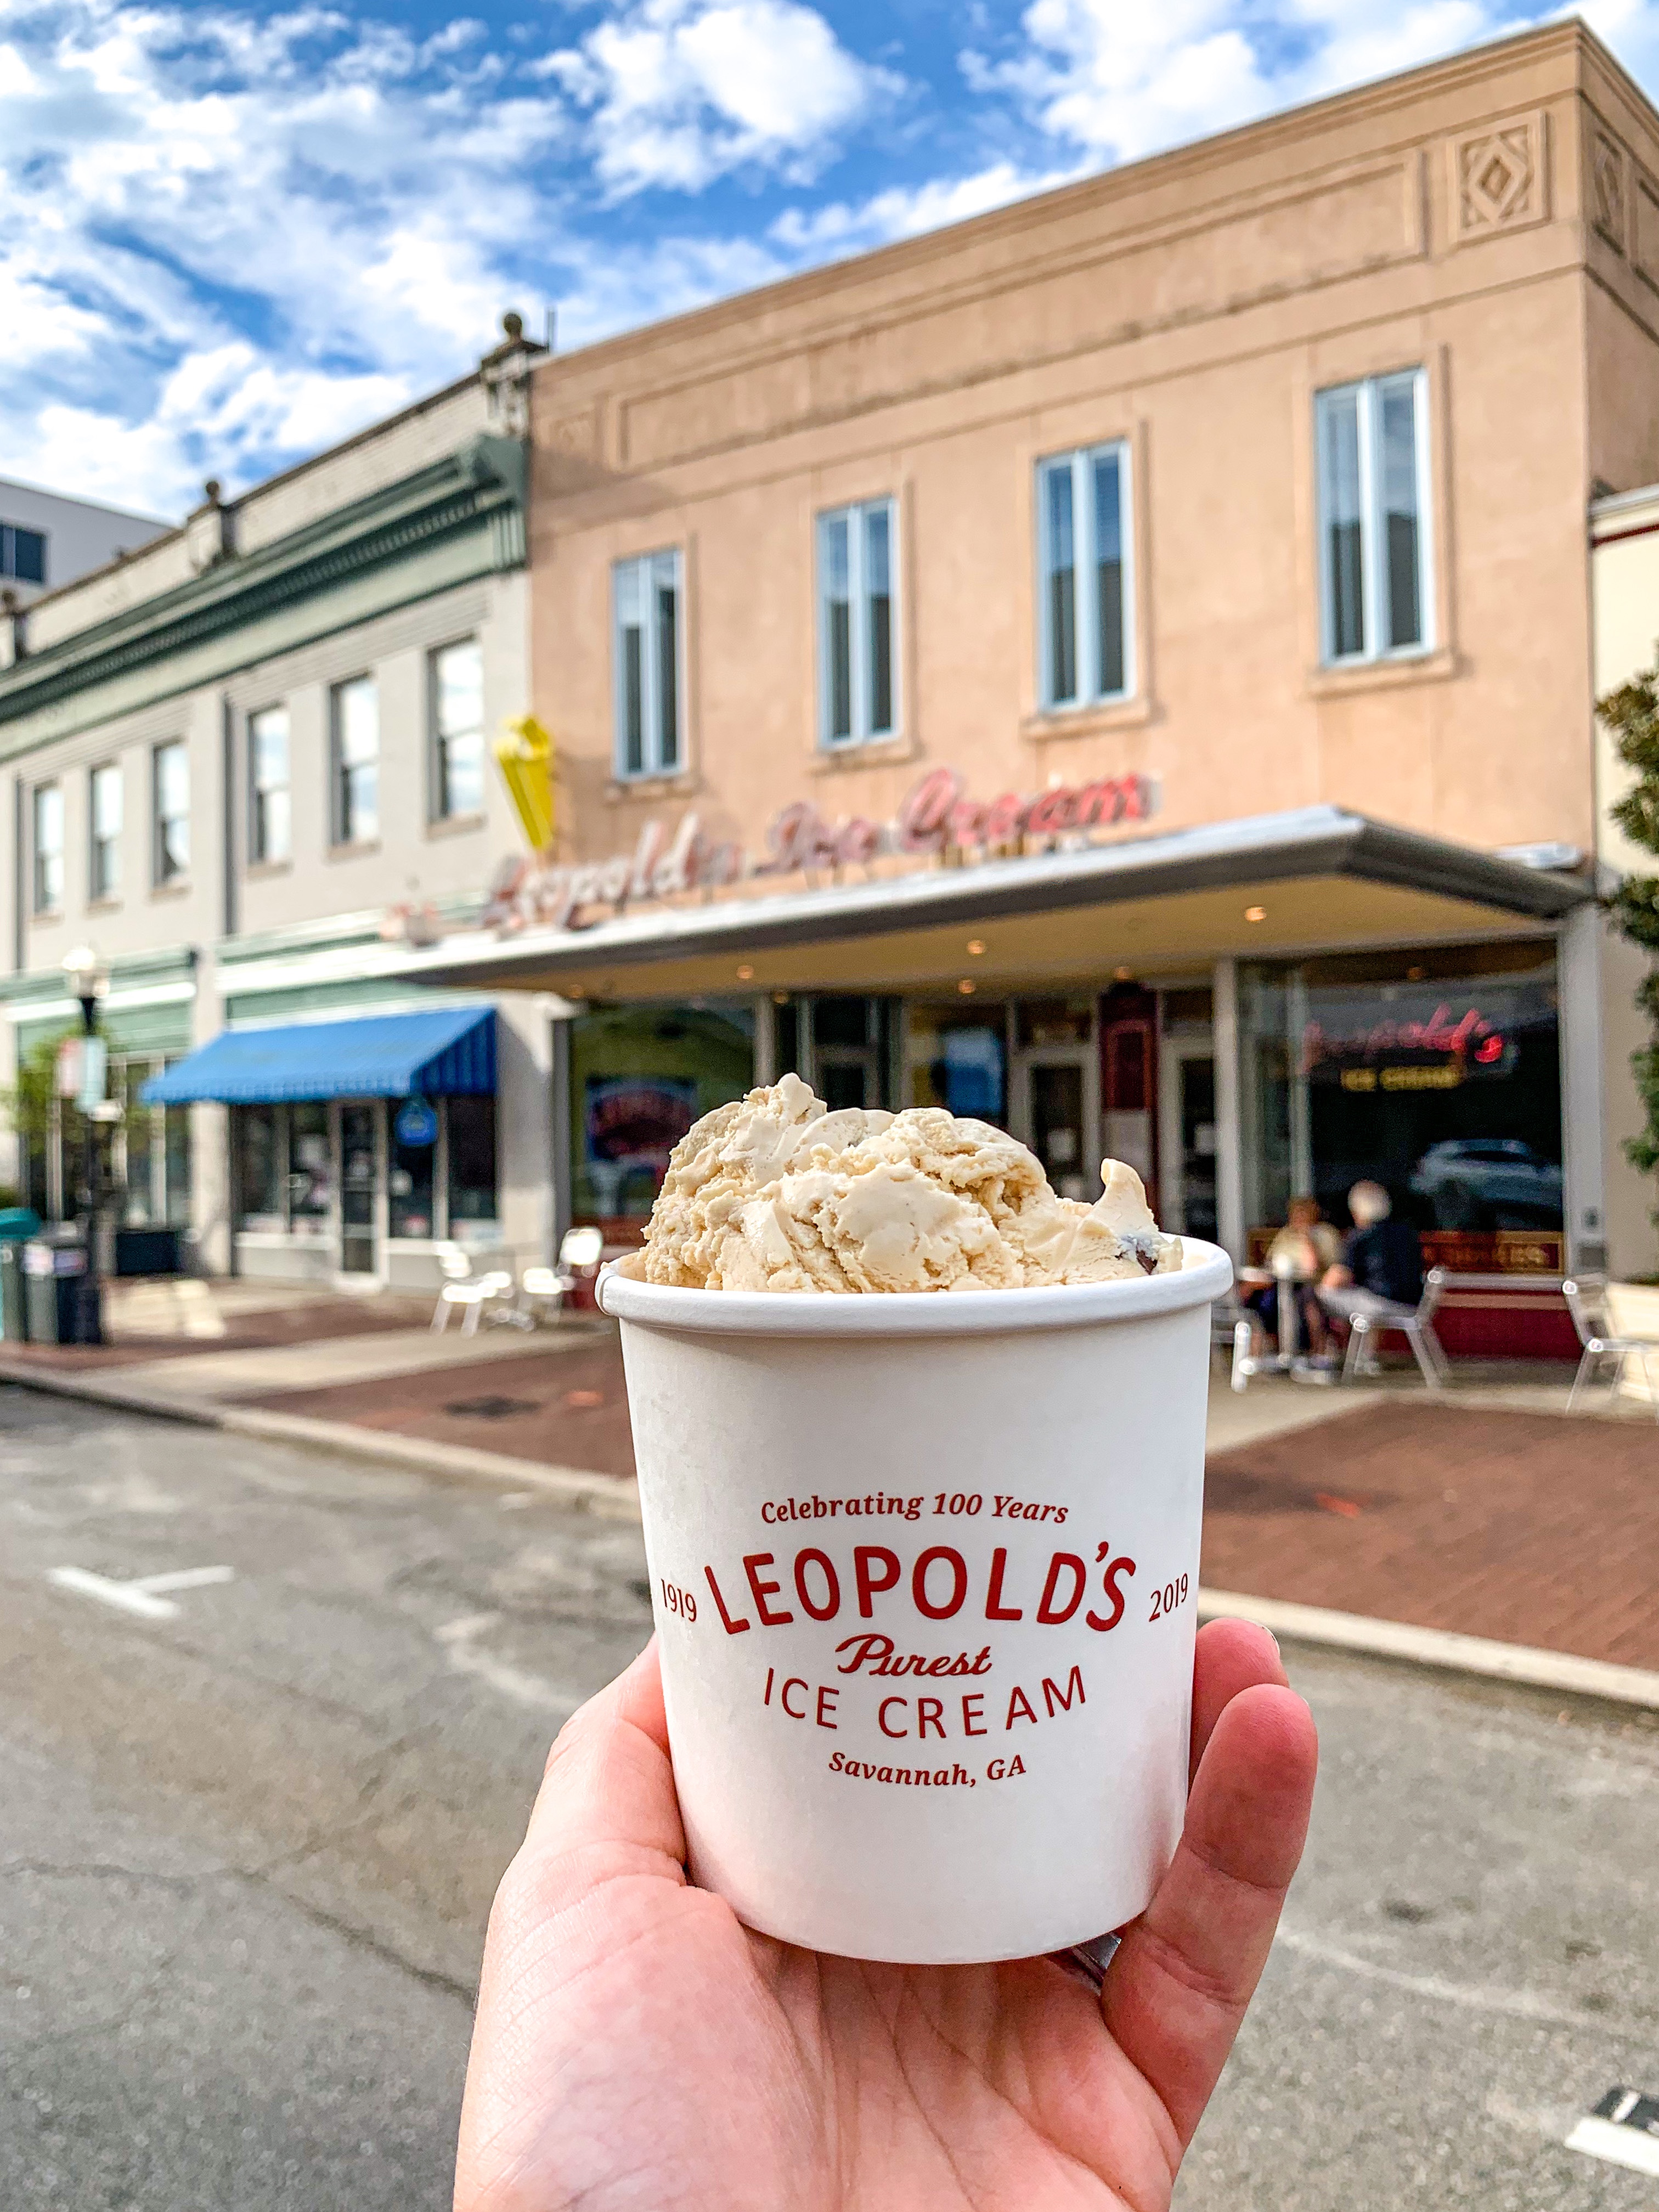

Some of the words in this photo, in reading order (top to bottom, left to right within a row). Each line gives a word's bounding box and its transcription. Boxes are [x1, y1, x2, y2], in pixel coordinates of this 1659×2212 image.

[761, 1491, 924, 1525] Celebrating
[932, 1492, 983, 1516] 100
[991, 1494, 1069, 1525] Years
[660, 1578, 697, 1623] 1919
[703, 1541, 1136, 1635] LEOPOLD'S
[1148, 1572, 1188, 1622] 2019
[834, 1633, 992, 1677] Purest
[764, 1667, 840, 1730] ICE
[878, 1664, 1087, 1739] CREAM
[828, 1751, 977, 1788] Savannah,
[986, 1754, 1026, 1781] GA
